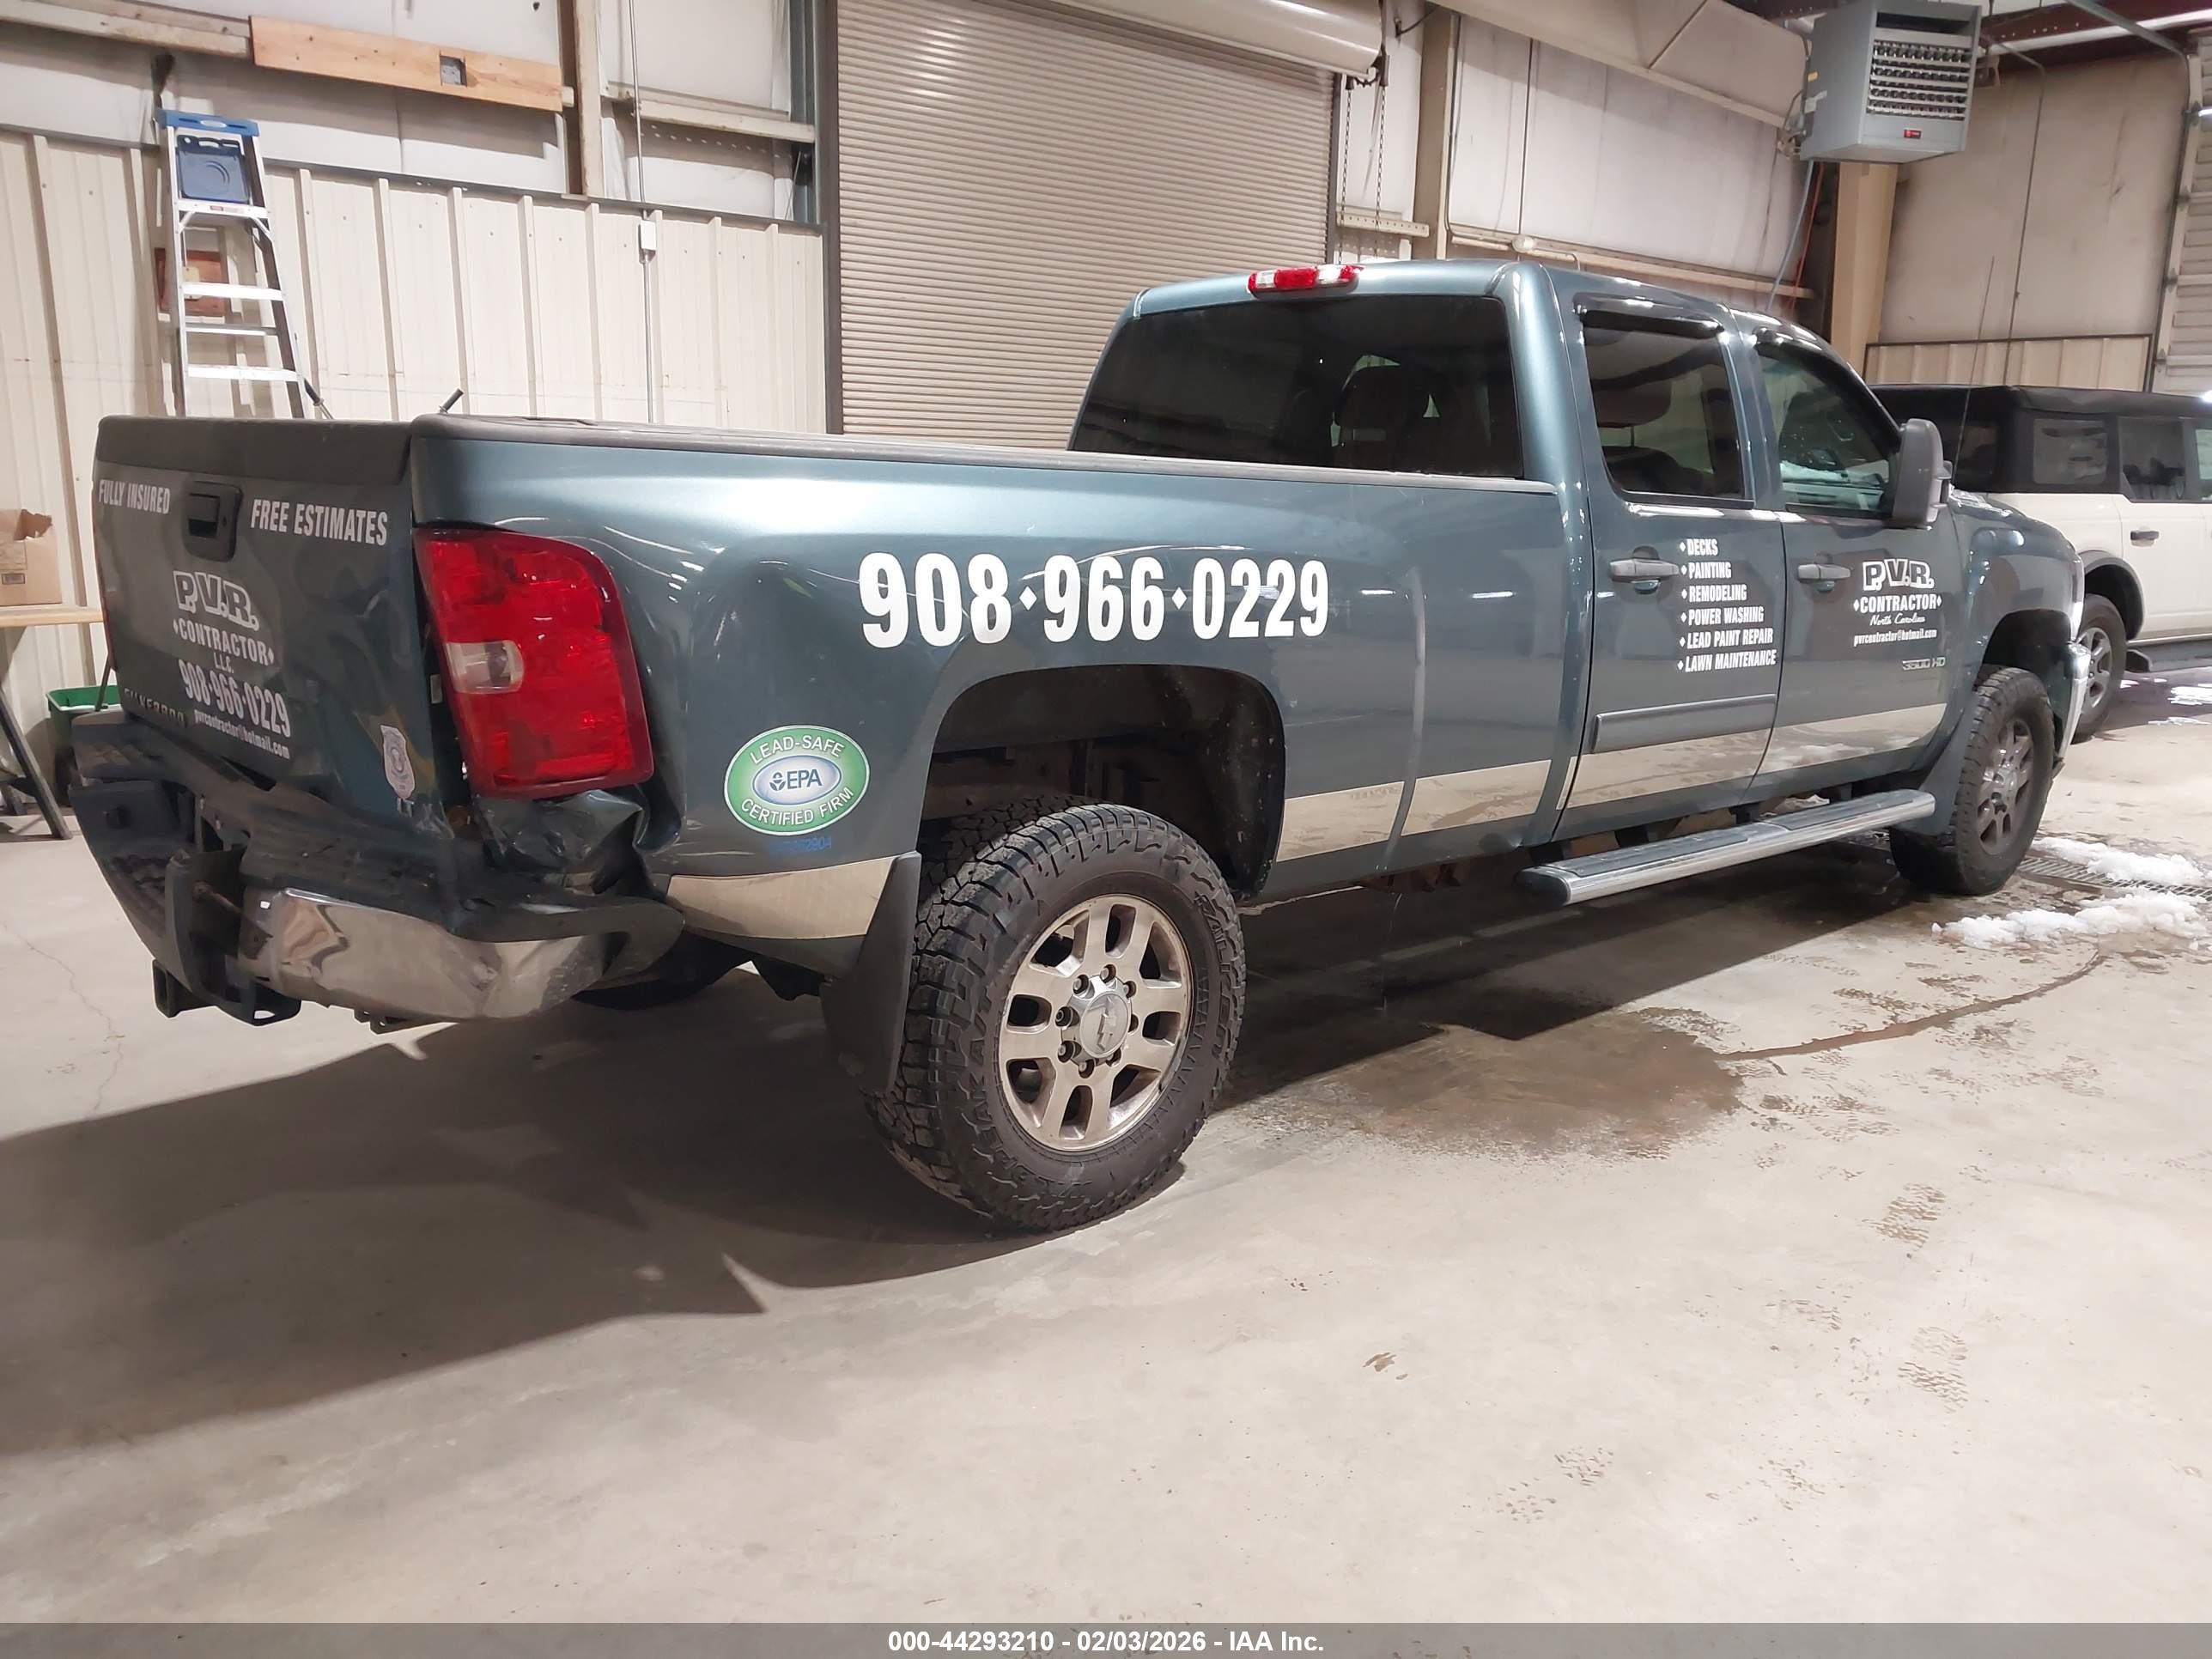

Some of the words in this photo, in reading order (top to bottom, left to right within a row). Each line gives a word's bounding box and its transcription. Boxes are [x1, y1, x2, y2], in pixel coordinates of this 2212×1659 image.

[98, 479, 125, 507] FULLY
[127, 486, 172, 514] INSURED
[251, 499, 290, 533] FREE
[294, 503, 388, 546] ESTIMATES
[1686, 538, 1718, 556] DECKS
[1688, 562, 1732, 579] PAINTING
[1689, 585, 1747, 602] REMODELING
[1860, 594, 1936, 613] CONTRACTOR
[1688, 608, 1721, 626] POWER
[1724, 606, 1765, 624] WASHING
[1869, 614, 1892, 626] North
[1894, 612, 1925, 624] Carolina
[179, 618, 269, 665] CONTRACTOR
[1687, 632, 1711, 649] LEAD
[1714, 630, 1741, 647] PAINT
[1742, 628, 1773, 646] REPAIR
[1854, 628, 1937, 647] pvrcontractor@hotmail.com
[1685, 654, 1712, 672] LAWN
[1715, 649, 1777, 670] MAINTENANCE
[1932, 657, 1946, 667] HD
[750, 735, 845, 764] LEAD-SAFE
[787, 769, 823, 790] EPA
[741, 798, 814, 825] CERTIFIED
[819, 787, 854, 818] FIRM
